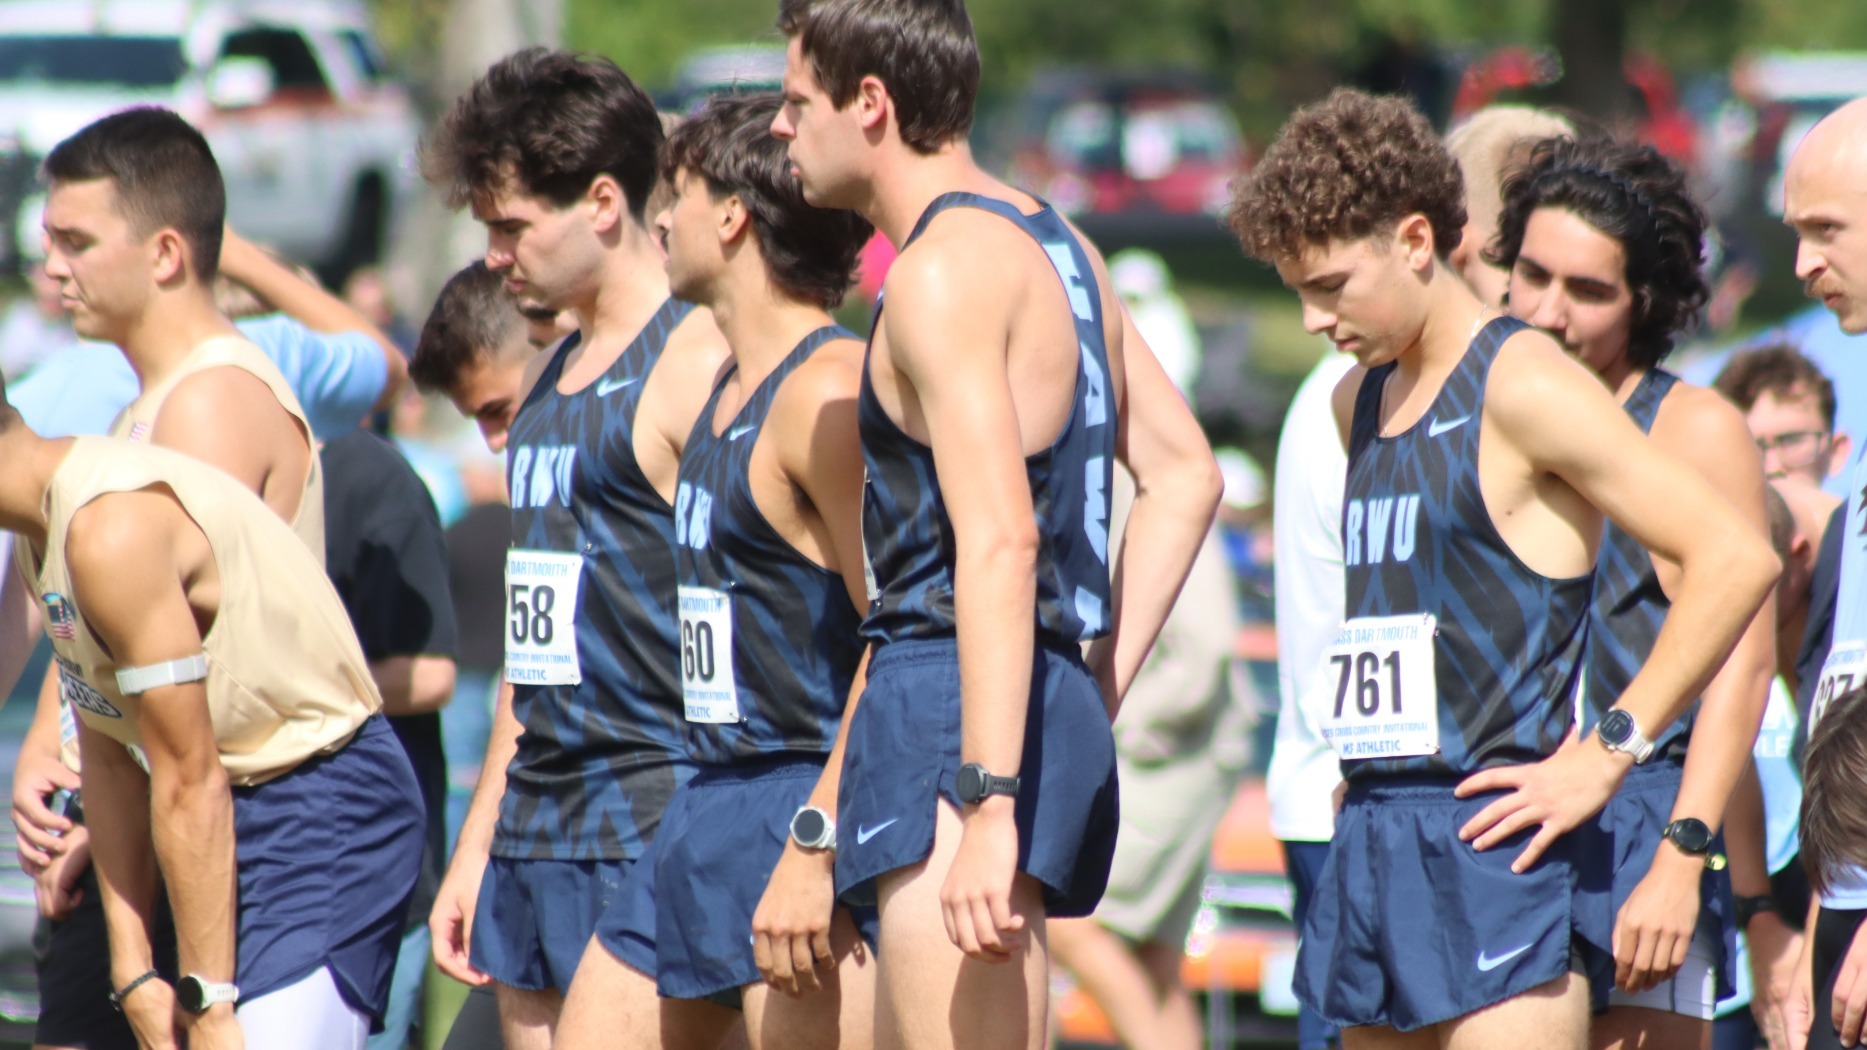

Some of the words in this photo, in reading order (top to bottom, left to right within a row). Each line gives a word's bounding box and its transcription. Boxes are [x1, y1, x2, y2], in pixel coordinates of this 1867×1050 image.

[512, 445, 576, 508] RWU
[675, 482, 712, 550] RW
[1346, 494, 1420, 565] RWU
[511, 560, 568, 576] DARTMOUTH
[510, 584, 555, 647] 58
[1355, 626, 1418, 643] DARTMOUTH
[530, 654, 572, 664] INVITATIONAL
[682, 619, 715, 684] 60
[511, 668, 547, 680] ATHLETIC
[1329, 651, 1402, 719] 761
[1354, 725, 1380, 736] COUNTRY
[1383, 722, 1428, 734] INVITATIONAL
[1356, 739, 1401, 754] ATHLETIC
